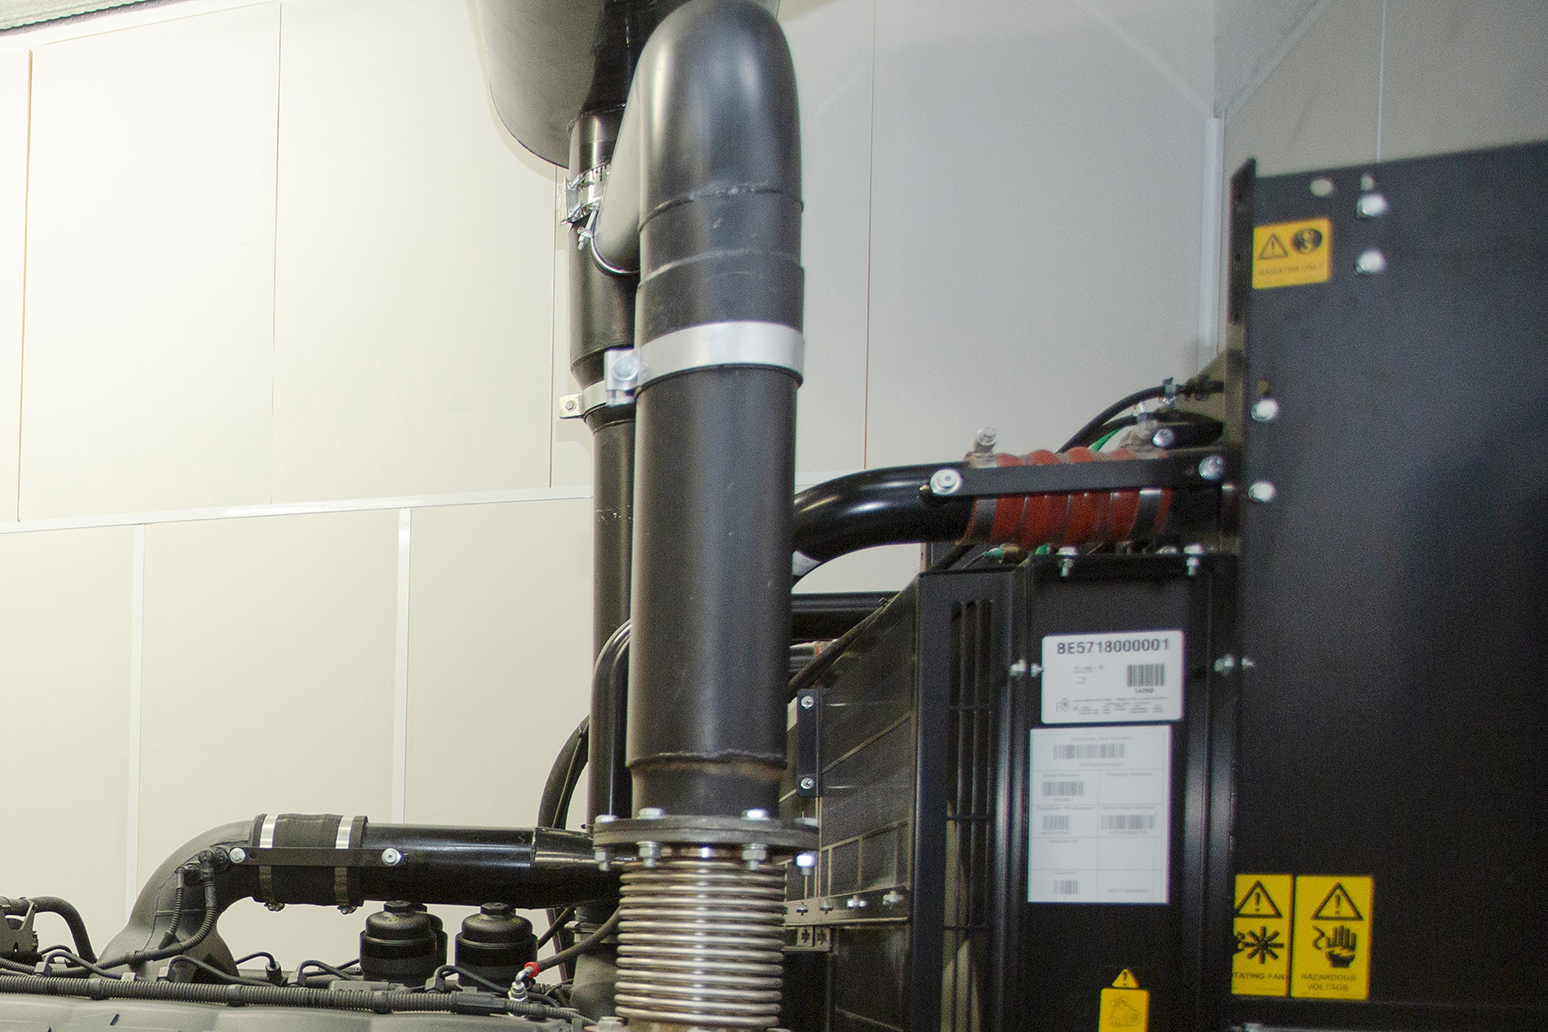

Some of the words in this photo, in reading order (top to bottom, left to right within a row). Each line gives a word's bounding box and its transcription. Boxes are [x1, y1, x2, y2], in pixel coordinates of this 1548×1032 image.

[1057, 638, 1169, 655] BE5718000001
[1301, 973, 1356, 981] HAZARDOUS
[1307, 983, 1349, 991] VOLTAGE
